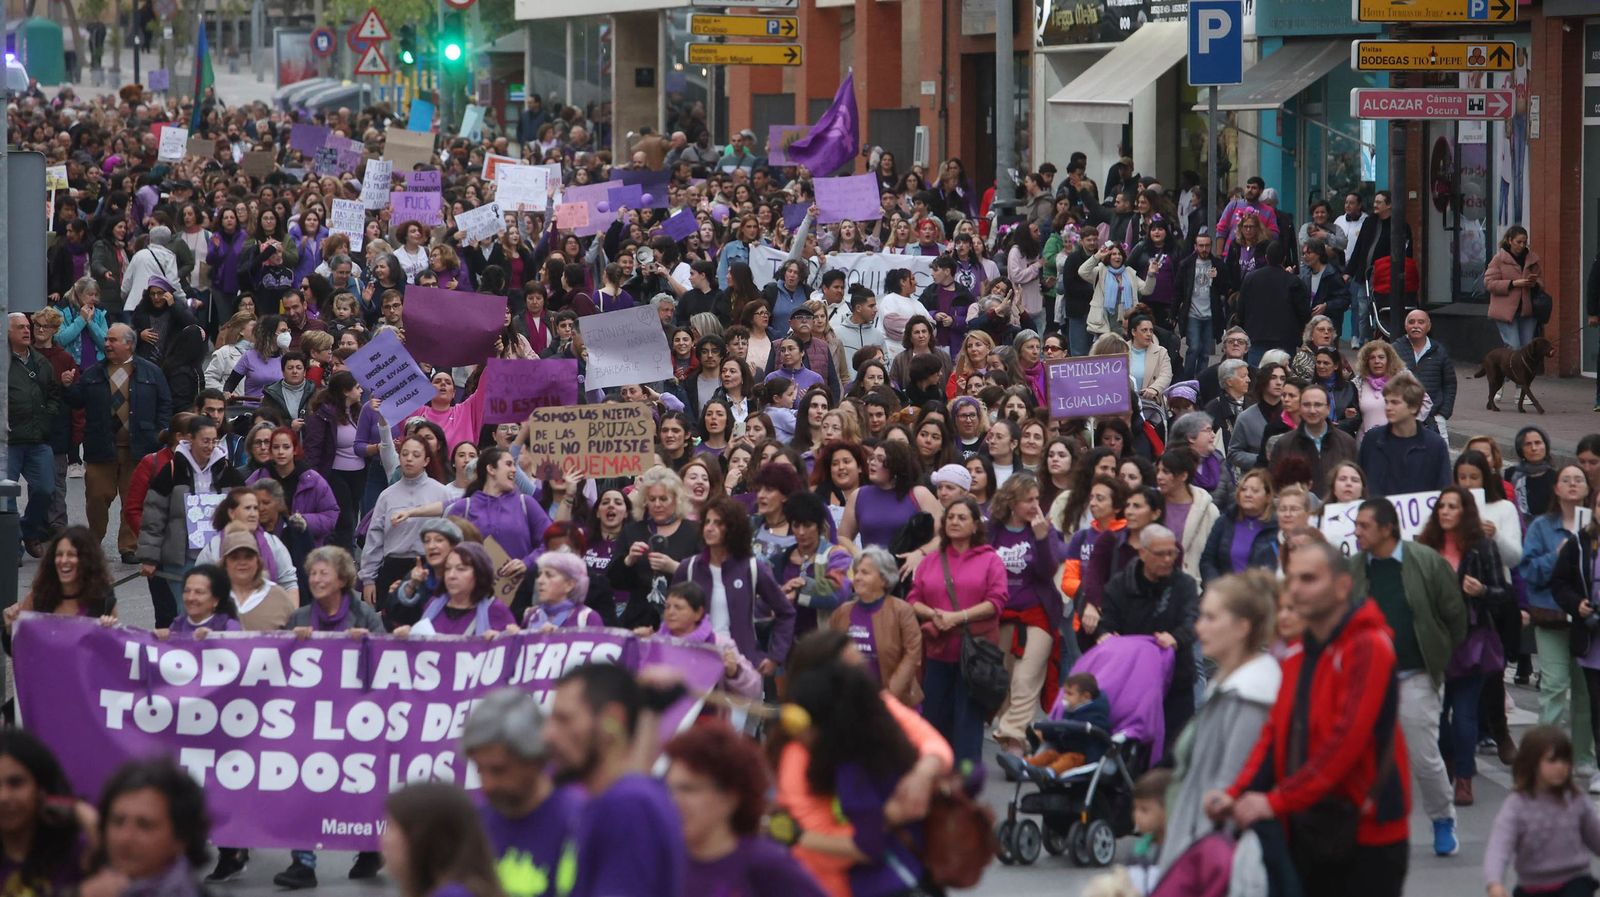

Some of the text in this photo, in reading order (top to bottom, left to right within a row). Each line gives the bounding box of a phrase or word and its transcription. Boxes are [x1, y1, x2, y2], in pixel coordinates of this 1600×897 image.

[1198, 9, 1232, 54] P
[1361, 56, 1410, 66] BODEGAS
[1438, 57, 1463, 66] PEPE
[1363, 98, 1424, 111] ALCAZAR
[1426, 94, 1463, 103] Cámara
[1426, 106, 1460, 115] Oscura
[404, 195, 431, 211] FUCK
[369, 352, 382, 363] NOS
[375, 378, 387, 390] SER
[386, 361, 410, 381] RIVALES
[1049, 360, 1123, 379] FEMINISMO
[395, 388, 420, 408] ALIADAS
[490, 397, 508, 415] NO
[1057, 392, 1122, 410] IGUALDAD
[533, 406, 641, 423] SOMOS LAS NIETAS
[535, 420, 648, 440] DE LAS BRUJAS
[532, 439, 651, 455] QUE NO PUDISTE
[563, 453, 643, 476] QUEMAR
[124, 640, 324, 688] TODAS
[340, 649, 442, 691] LAS
[99, 688, 296, 740] TODOS
[312, 700, 413, 742] LOS
[180, 747, 377, 794] TODOS
[321, 818, 373, 836] Marea
